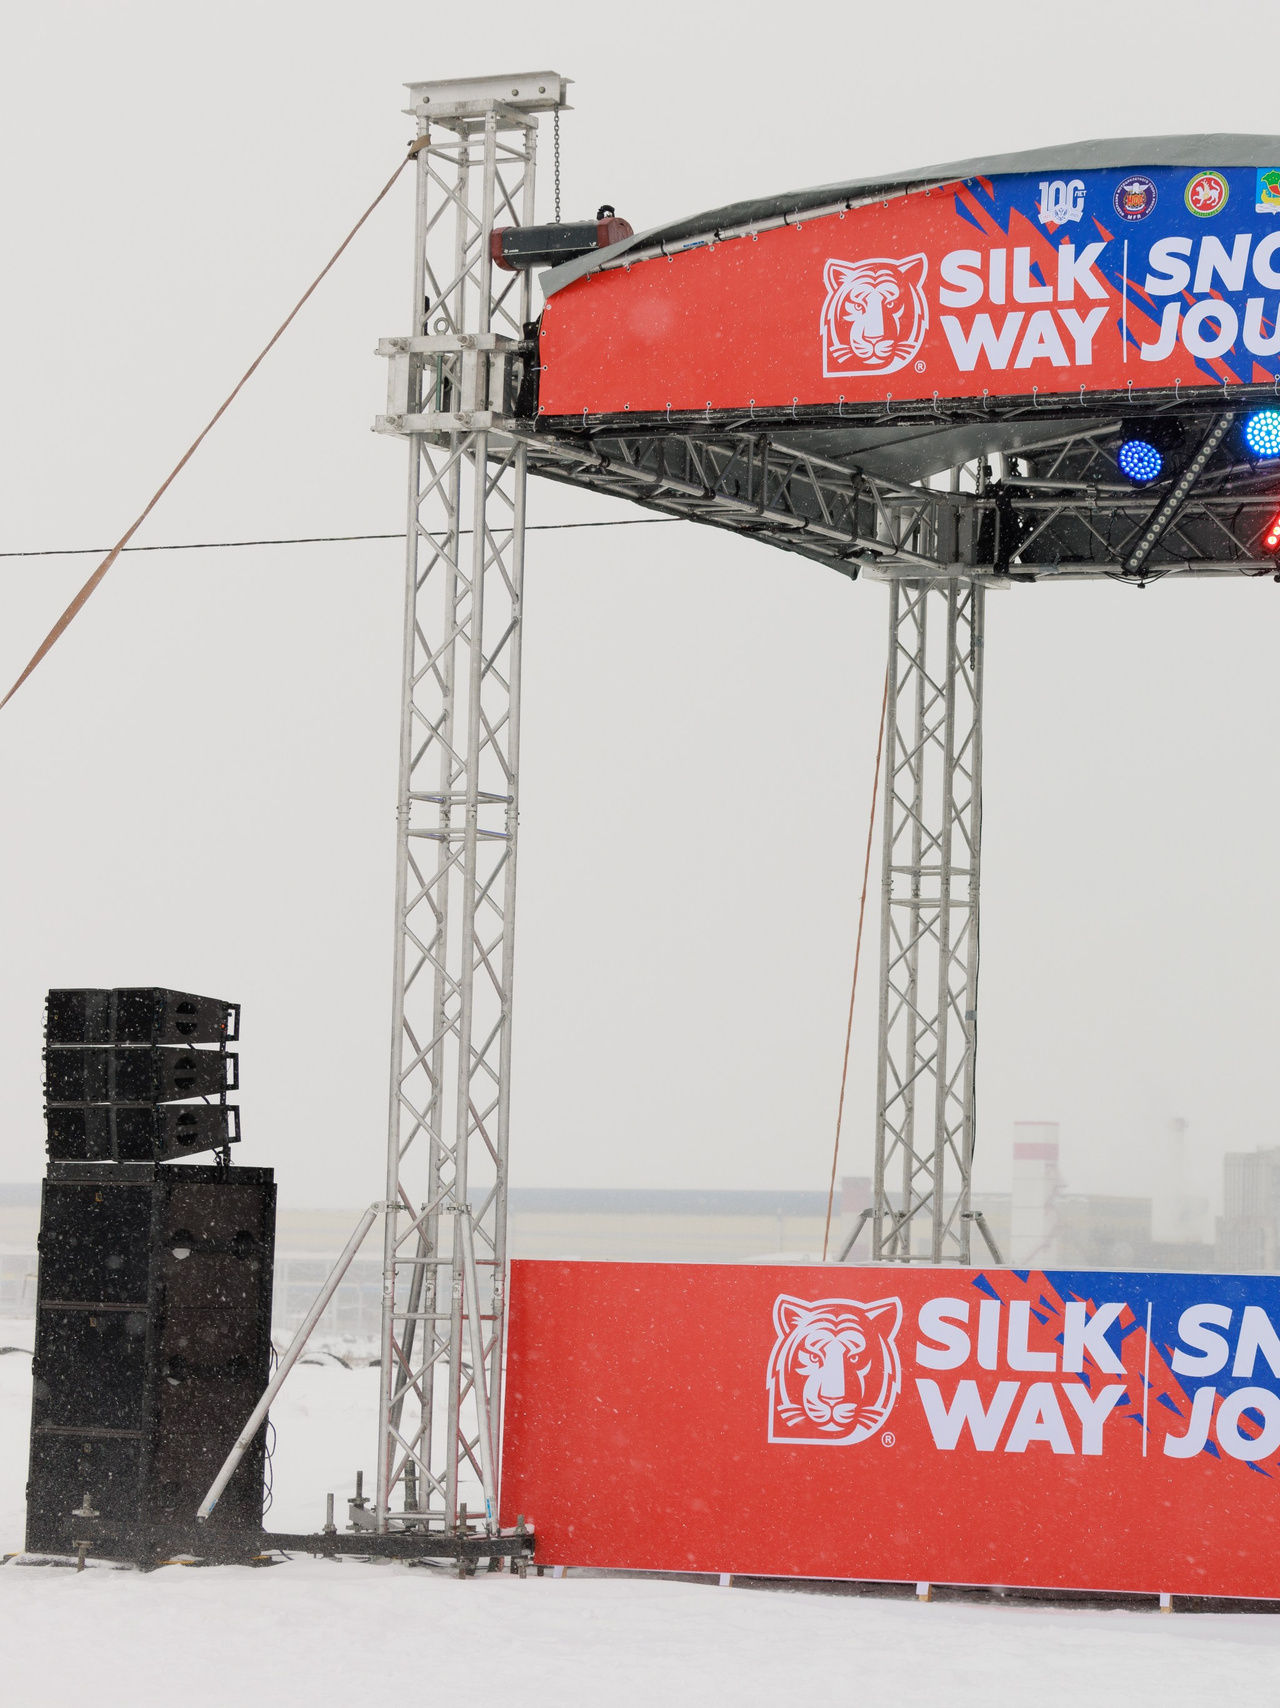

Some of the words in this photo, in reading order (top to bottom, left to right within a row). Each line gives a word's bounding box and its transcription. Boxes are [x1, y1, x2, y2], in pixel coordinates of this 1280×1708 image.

[1038, 179, 1086, 216] 100
[939, 241, 1110, 309] SILK
[939, 306, 1110, 372] WAY
[915, 1297, 1128, 1375] SILK
[914, 1378, 1128, 1456] WAY
